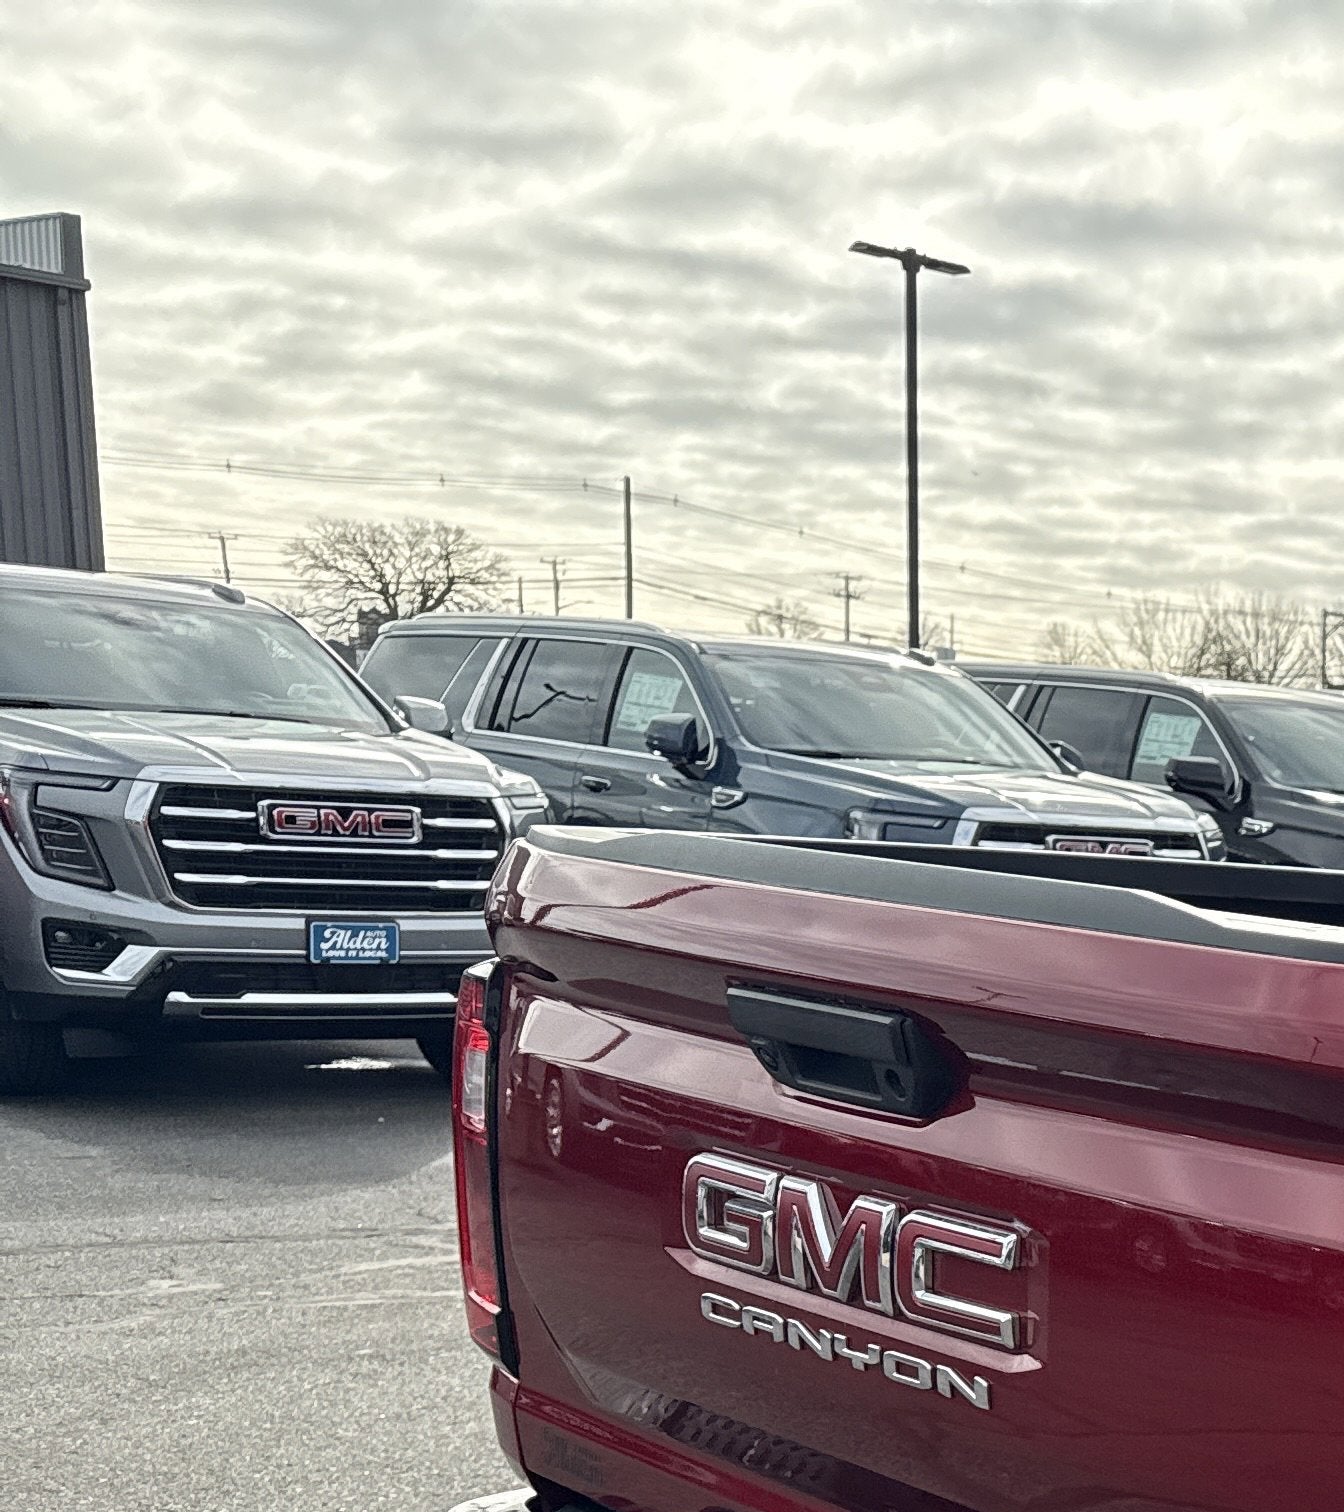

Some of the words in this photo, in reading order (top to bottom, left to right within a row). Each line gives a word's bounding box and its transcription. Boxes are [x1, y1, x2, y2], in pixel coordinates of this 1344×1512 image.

[272, 807, 413, 837] GMC
[320, 928, 390, 949] Alden
[682, 1152, 1023, 1350] GMC
[700, 1292, 993, 1411] CANYON
